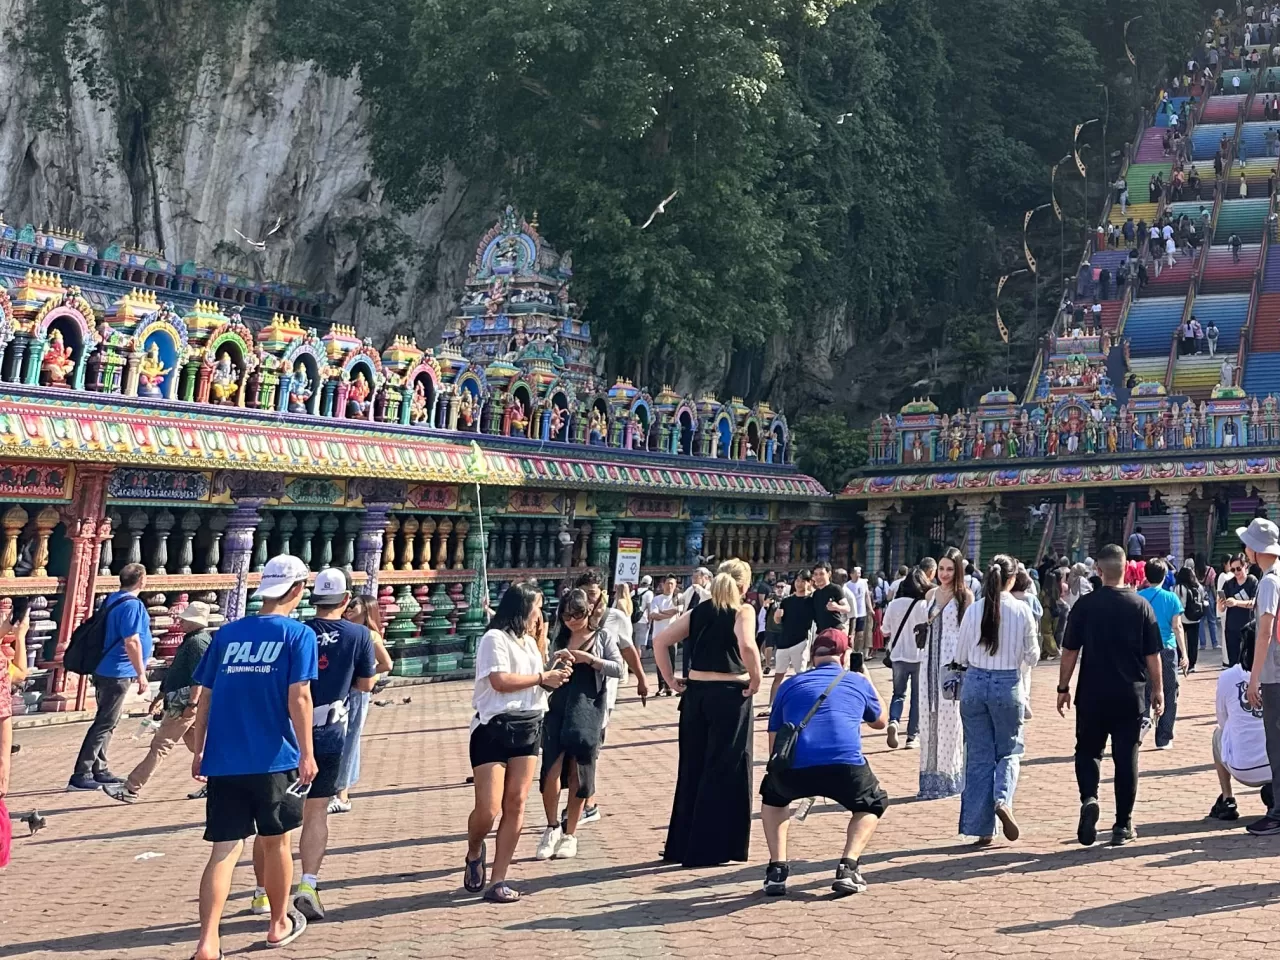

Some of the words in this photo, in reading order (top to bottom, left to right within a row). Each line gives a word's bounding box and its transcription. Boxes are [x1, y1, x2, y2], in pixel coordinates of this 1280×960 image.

[222, 641, 284, 664] PAJU
[227, 665, 254, 674] RUNNING
[254, 664, 271, 673] CLUB
